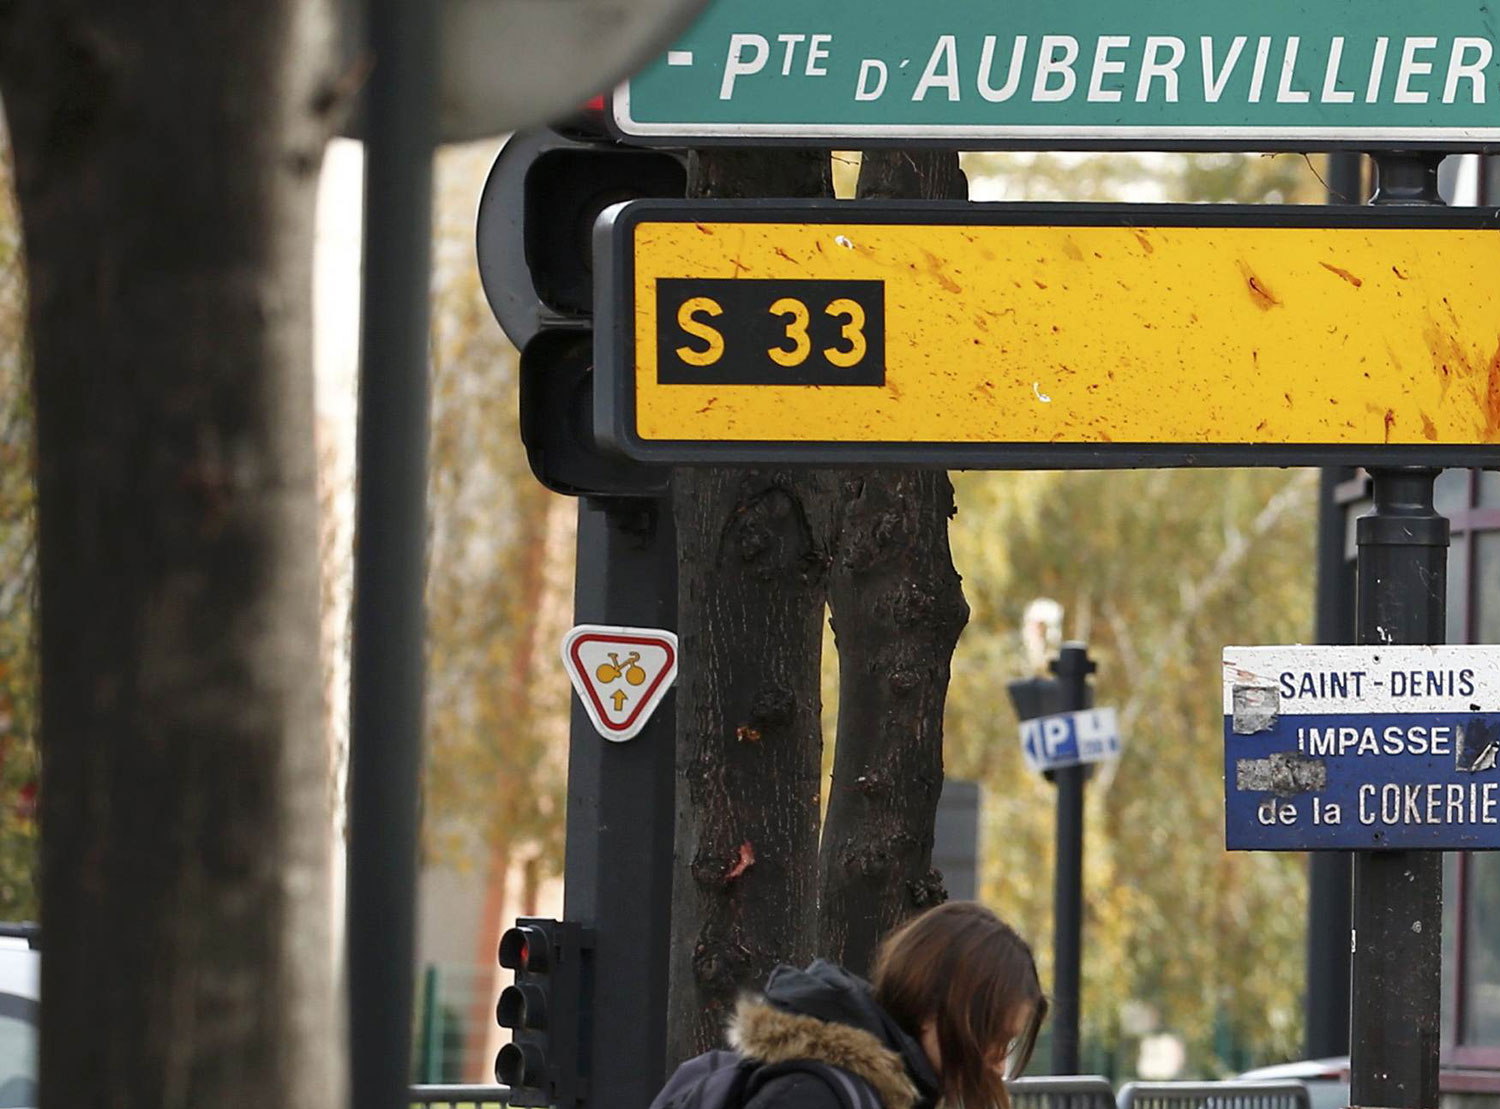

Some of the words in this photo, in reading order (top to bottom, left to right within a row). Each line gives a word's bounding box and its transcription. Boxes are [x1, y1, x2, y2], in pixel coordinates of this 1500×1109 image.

[675, 297, 725, 367] S
[767, 297, 867, 368] 33
[1298, 725, 1452, 757] IMPASSE
[1257, 797, 1298, 826] de
[1313, 796, 1342, 826] la
[1358, 782, 1500, 826] COKERIE
